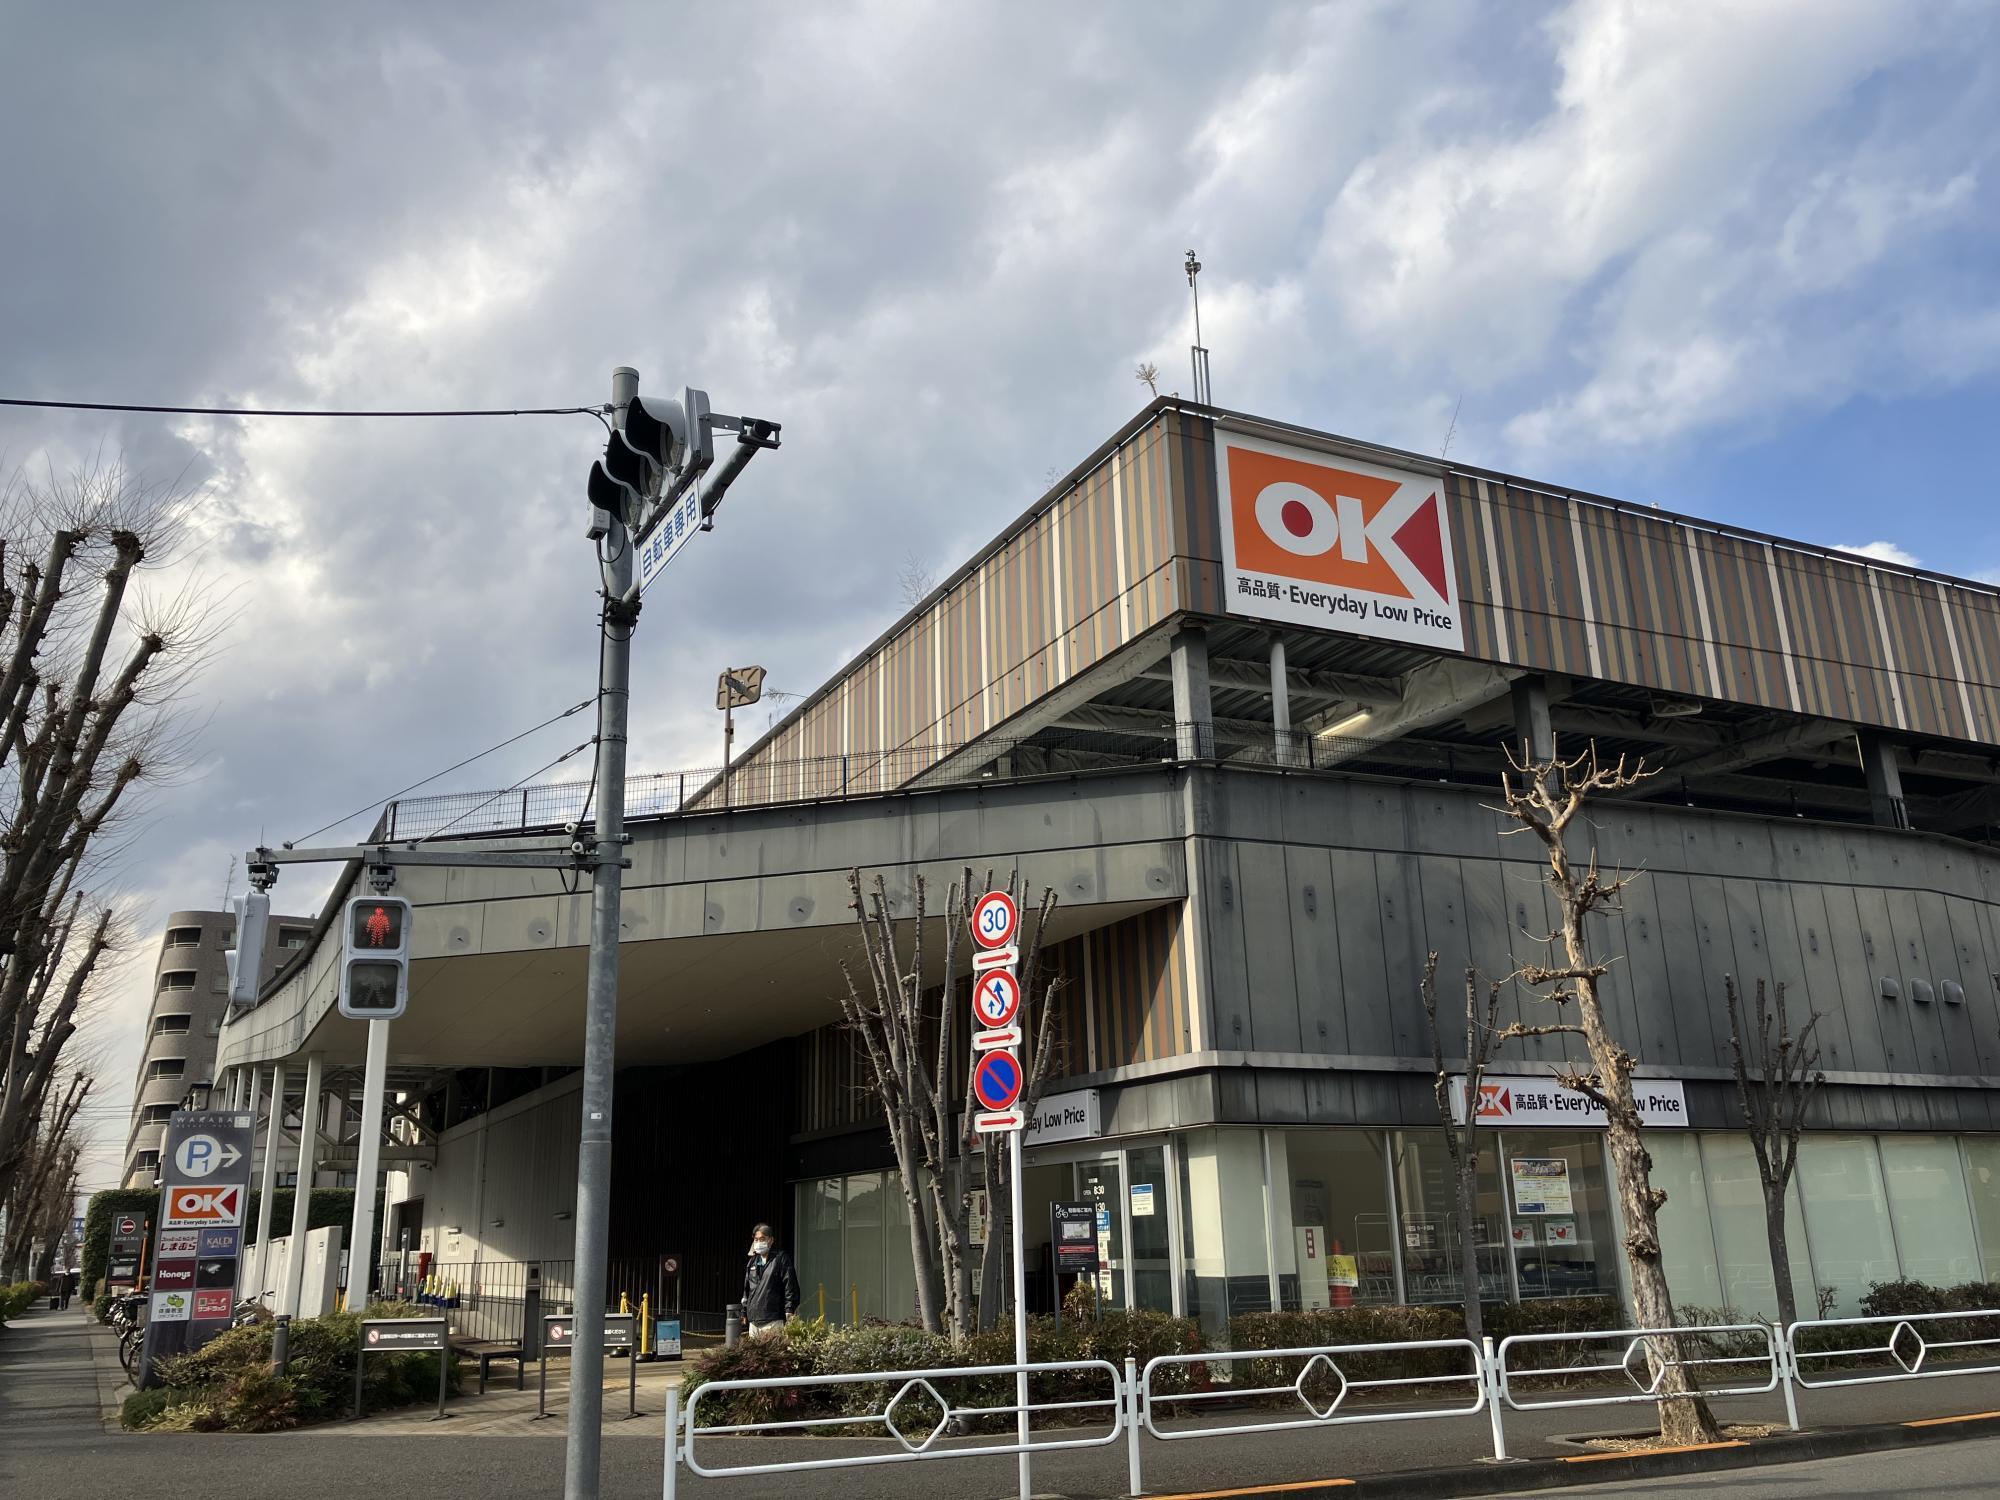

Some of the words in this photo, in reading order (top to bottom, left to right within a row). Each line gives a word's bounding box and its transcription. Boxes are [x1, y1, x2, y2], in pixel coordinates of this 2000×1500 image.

[643, 492, 697, 578] 自転車専用
[1255, 480, 1446, 606] OK
[1290, 585, 1368, 620] Everyday
[1373, 600, 1408, 622] Low
[1413, 608, 1453, 630] Price
[982, 906, 1007, 933] 30
[1649, 1095, 1680, 1112] Price
[1044, 1112, 1062, 1128] Low
[1064, 1106, 1085, 1125] Price
[178, 1188, 236, 1217] OK
[160, 1242, 197, 1251] しまむら
[207, 1237, 232, 1245] KALDI
[160, 1270, 191, 1280] Honeys
